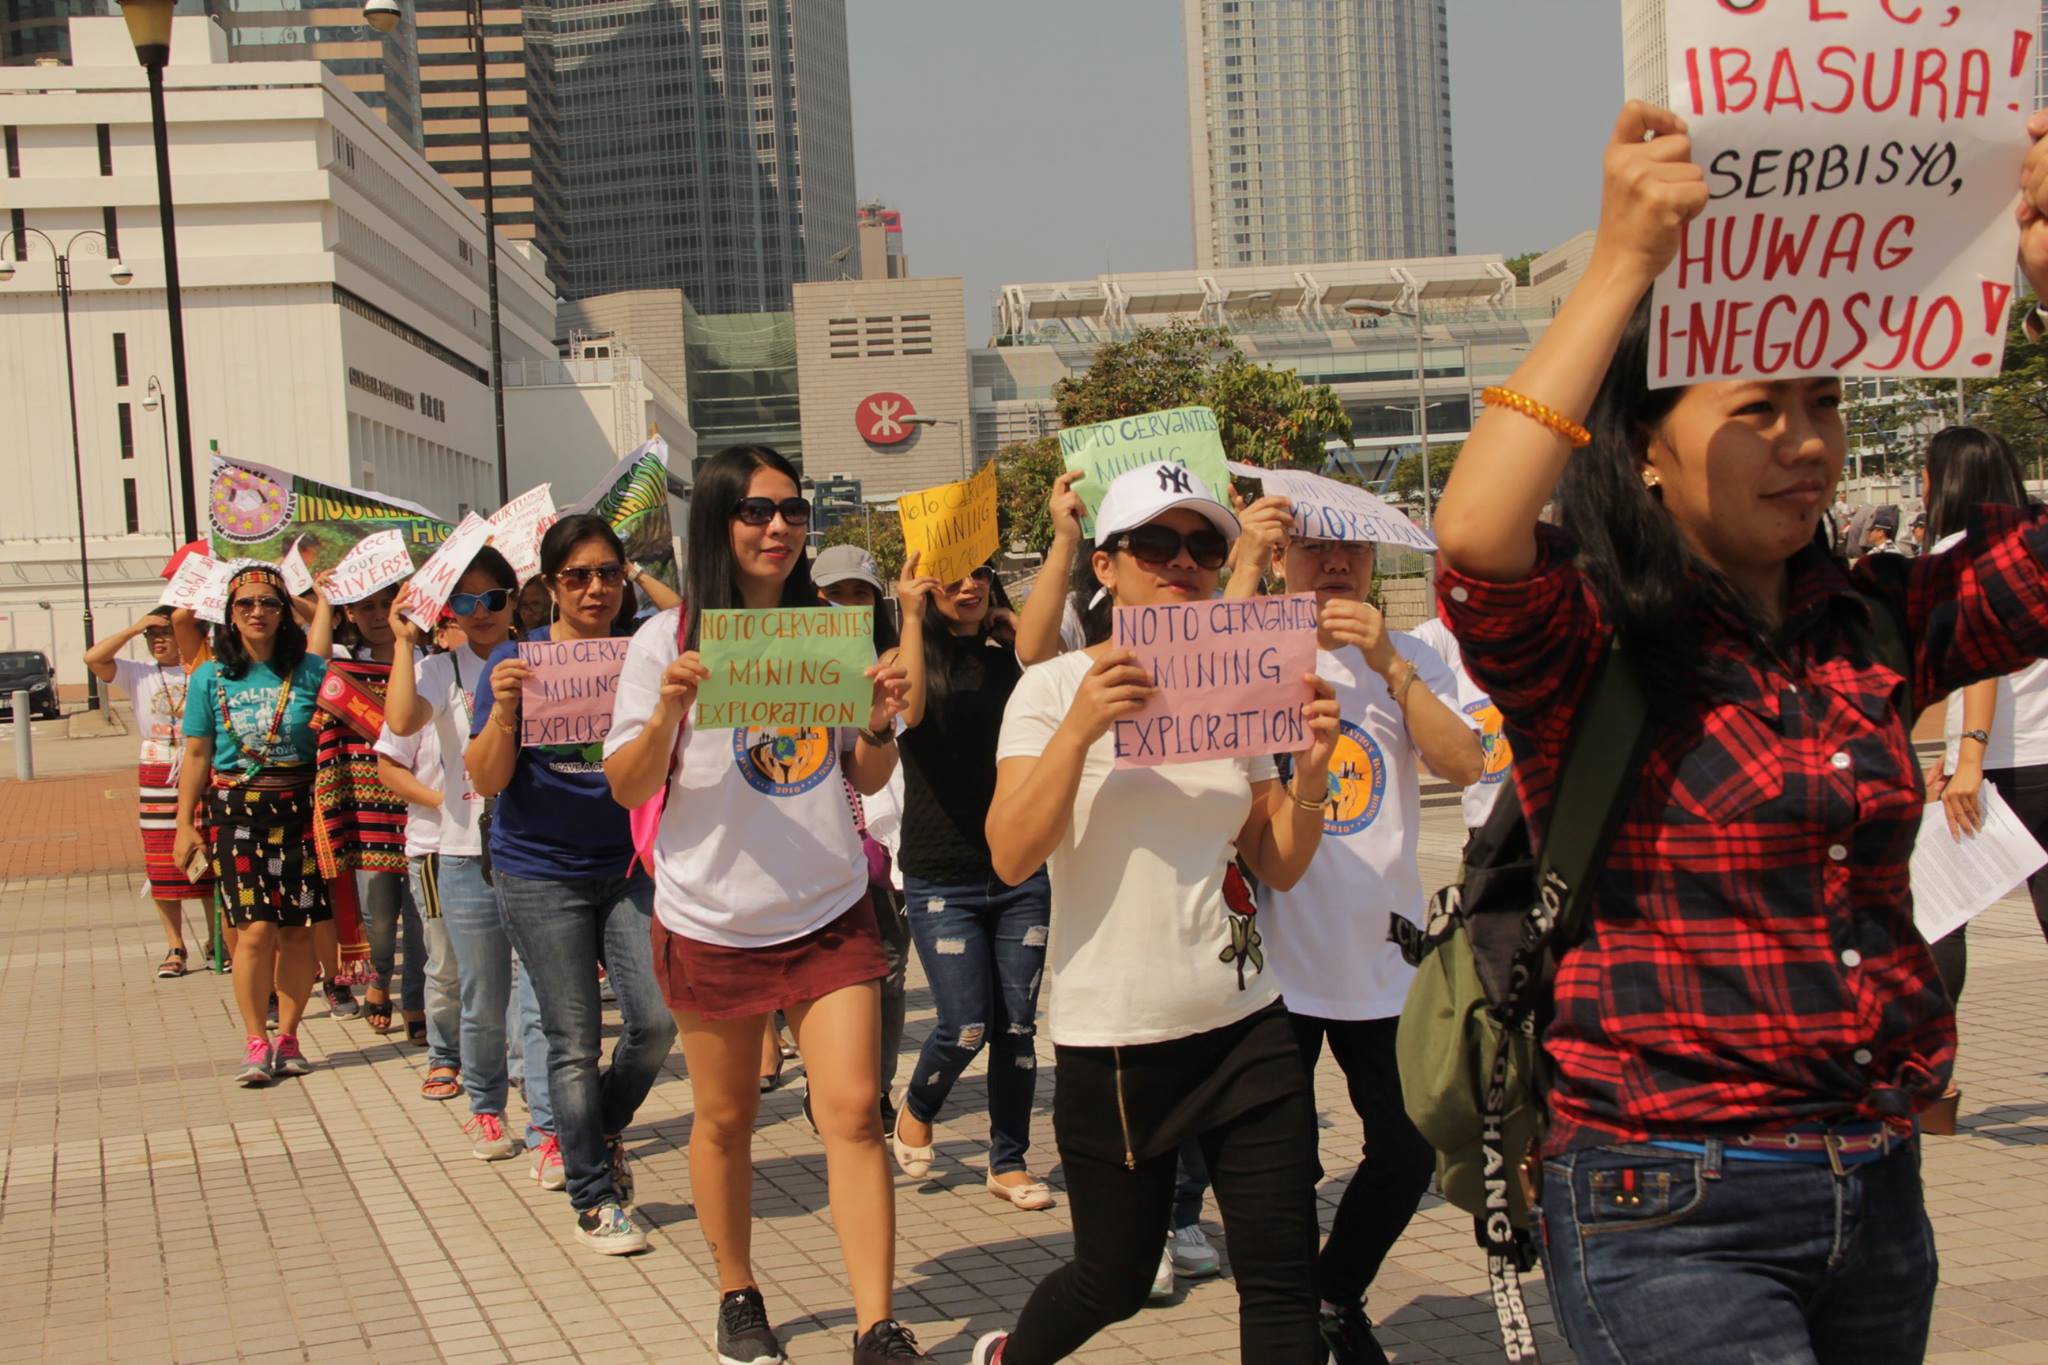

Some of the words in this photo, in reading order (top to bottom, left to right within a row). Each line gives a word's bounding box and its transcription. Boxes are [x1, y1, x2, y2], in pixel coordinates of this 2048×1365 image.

[1685, 29, 2033, 122] IBASURA!
[1708, 140, 1963, 200] SERBISYO,
[1677, 212, 1916, 290] HUWAG
[1657, 280, 2011, 379] I-NEGOSYO!
[729, 659, 841, 687] MINING
[1153, 647, 1281, 690] MINING
